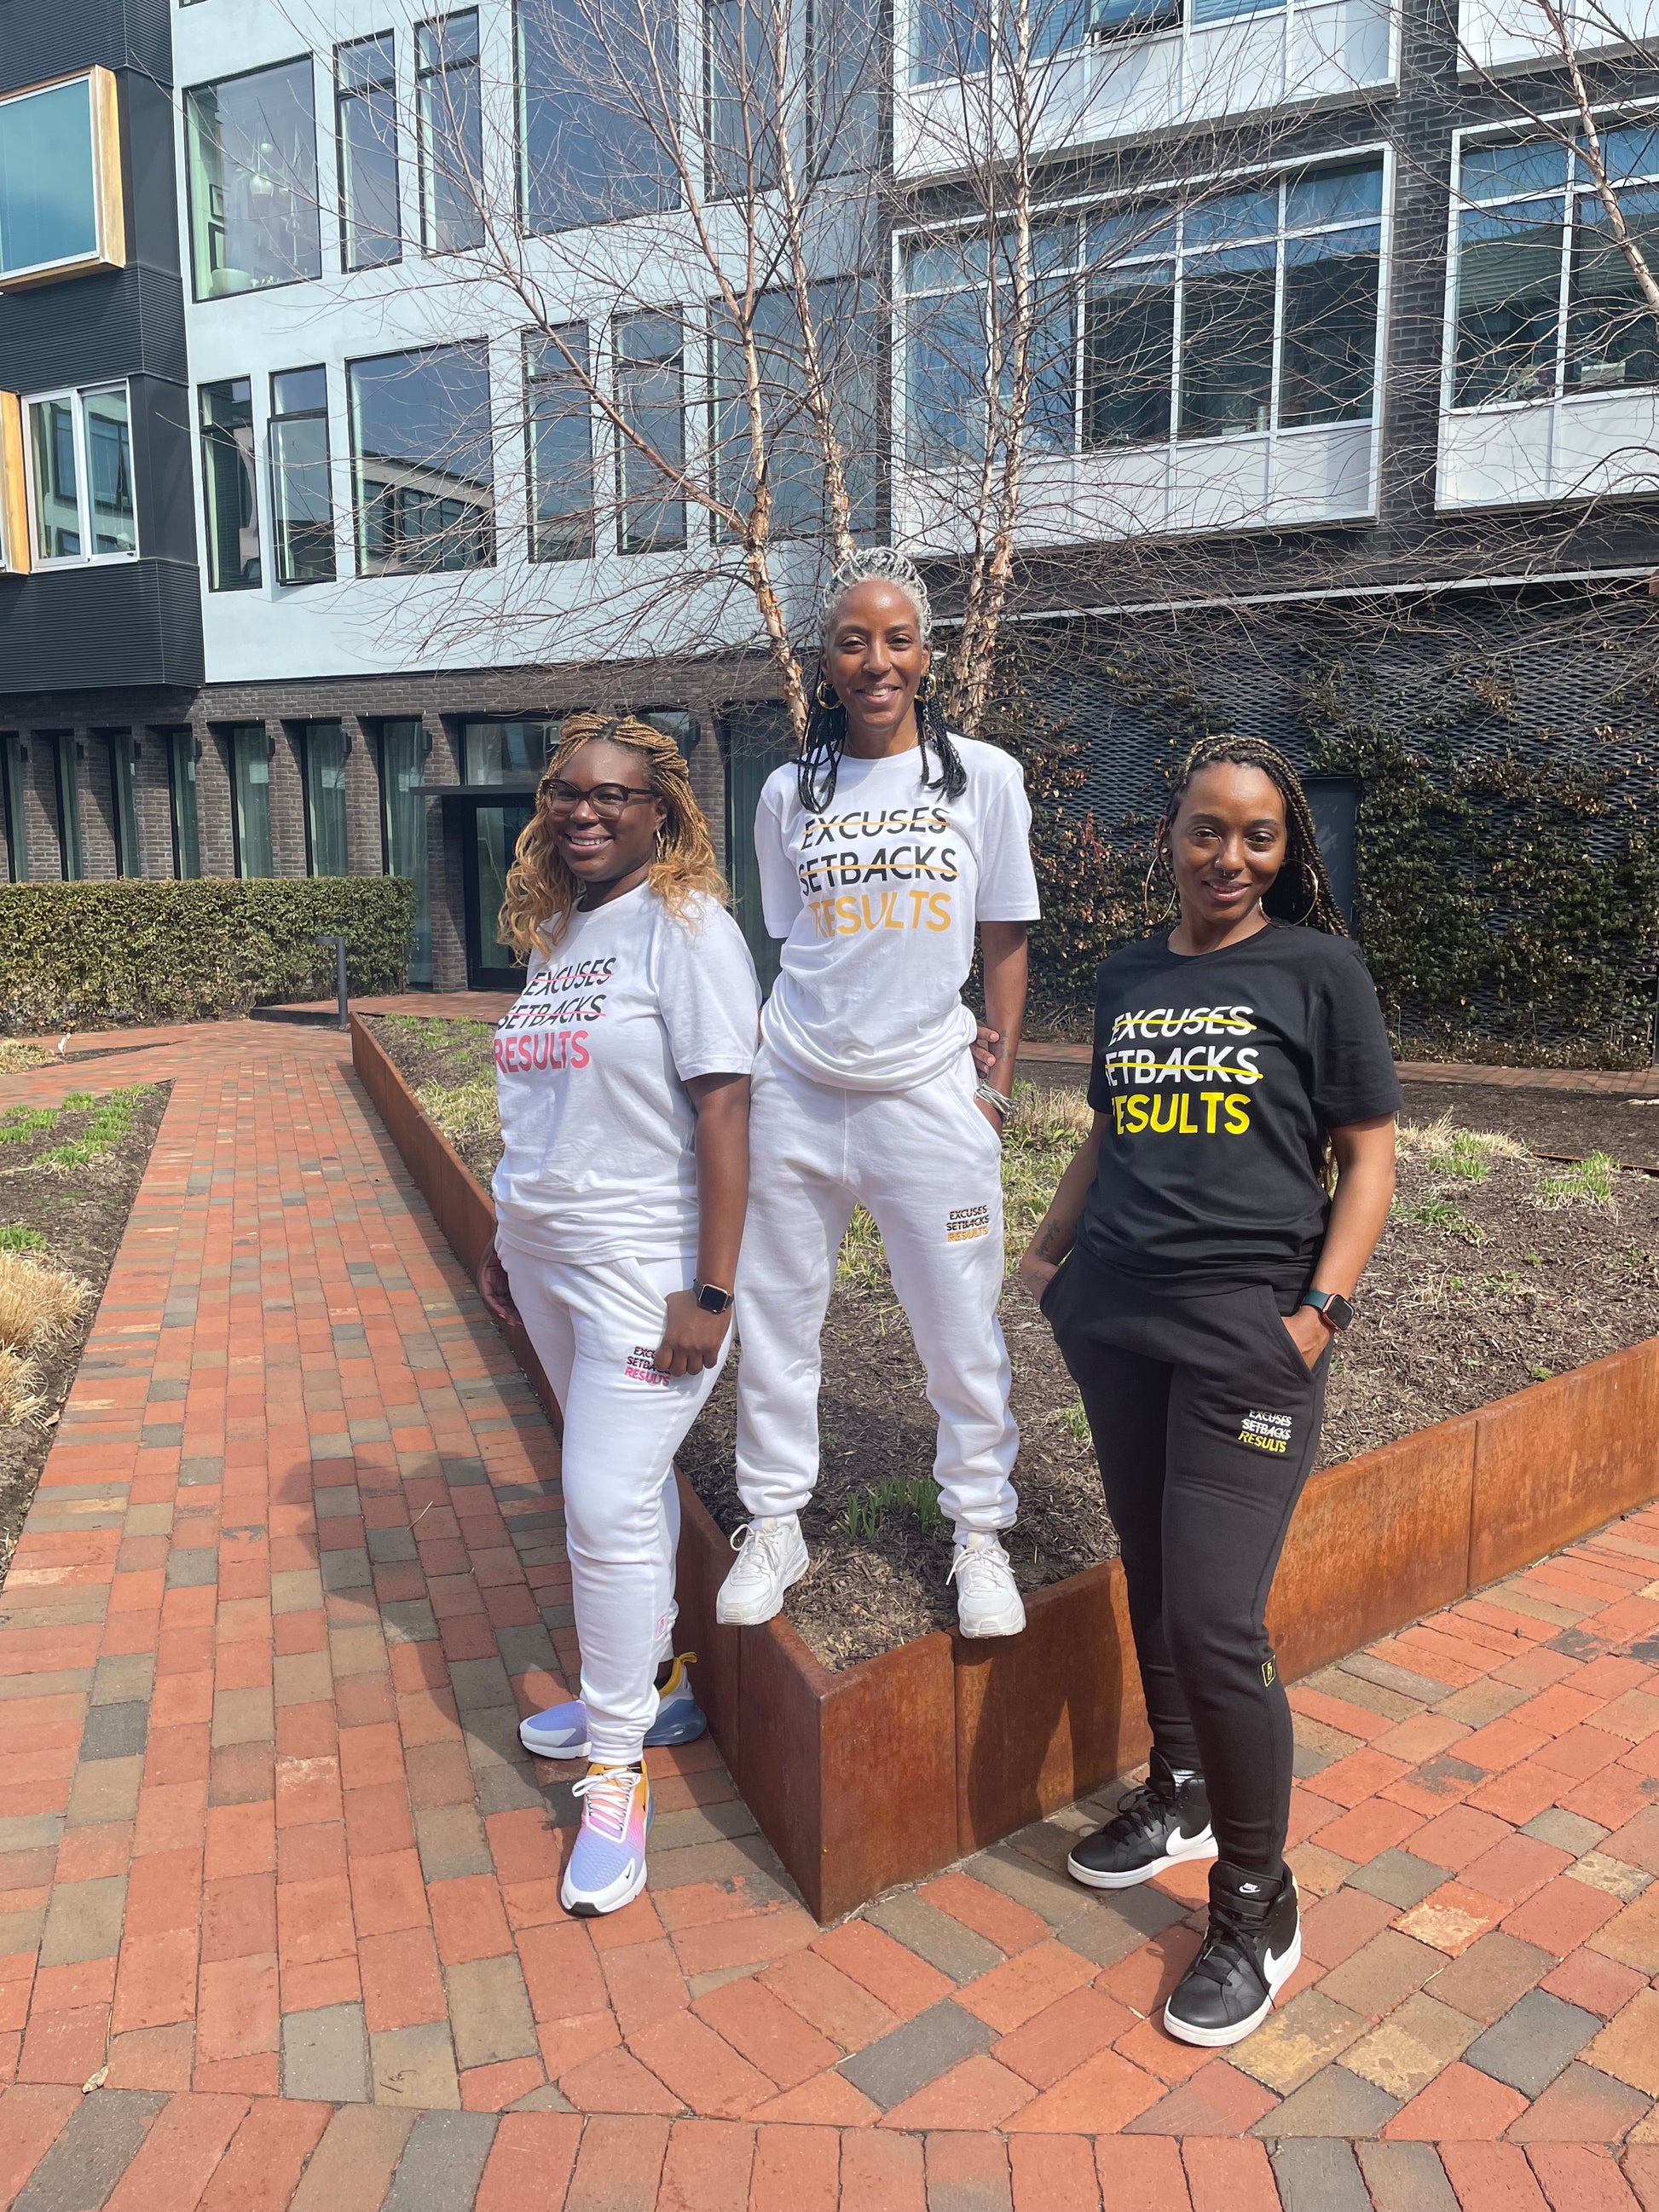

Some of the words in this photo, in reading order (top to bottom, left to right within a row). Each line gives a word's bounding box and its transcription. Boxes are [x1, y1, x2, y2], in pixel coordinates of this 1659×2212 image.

[800, 806, 950, 851] EXCUSES
[798, 846, 959, 897] SETBACKS
[523, 957, 617, 996] EXCUSES
[1108, 1006, 1256, 1048] EXCUSES
[494, 1030, 590, 1074] RESULTS
[1106, 1046, 1262, 1087] ETBACKS
[1112, 1092, 1251, 1135] ESULTS
[945, 1215, 990, 1231] SETBACKS
[949, 1205, 987, 1220] EXCUSES
[948, 1226, 988, 1242] RESULTS
[625, 1366, 670, 1387] RESULTS
[1241, 1418, 1291, 1439] SETBACKS
[1249, 1410, 1292, 1426] EXCUSES
[1238, 1430, 1286, 1453] RESULTS
